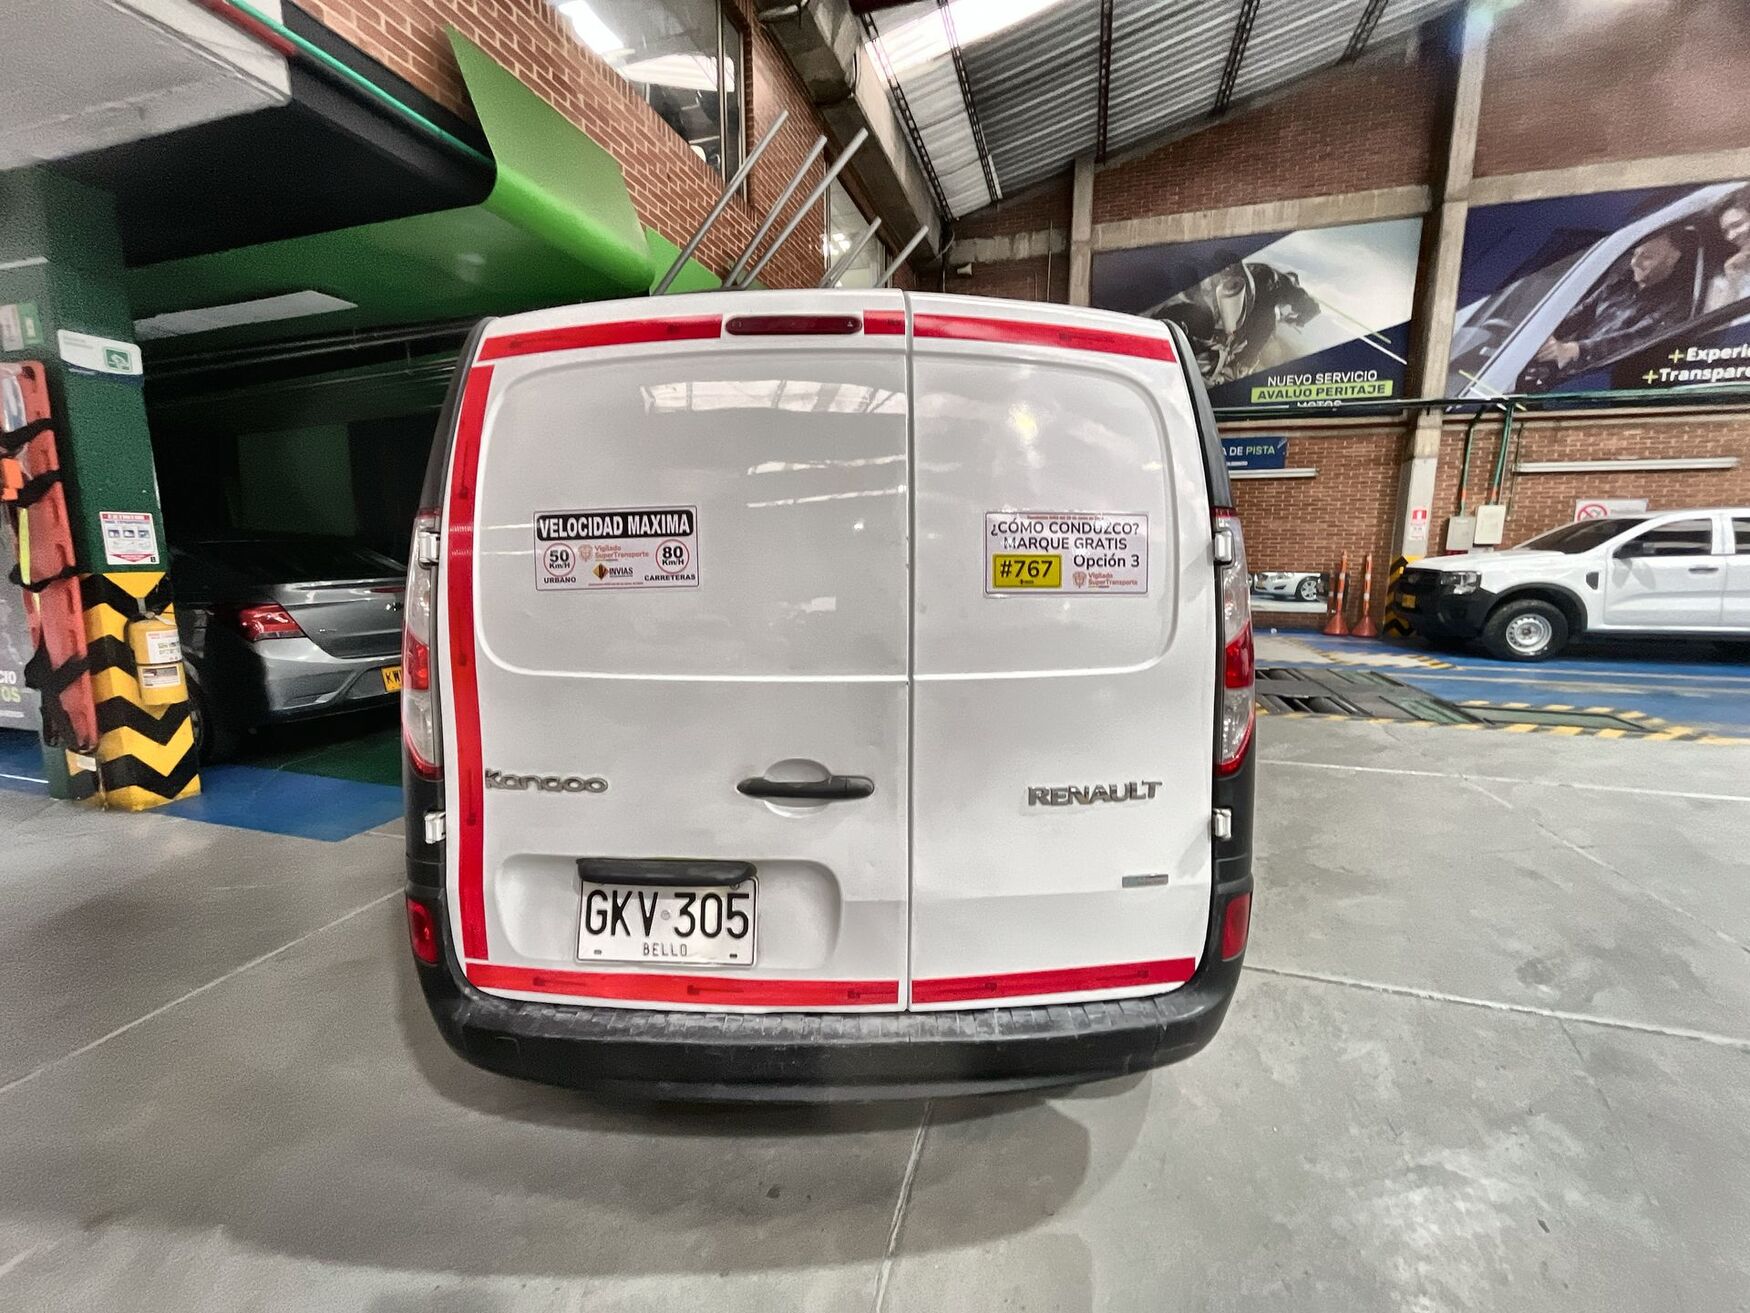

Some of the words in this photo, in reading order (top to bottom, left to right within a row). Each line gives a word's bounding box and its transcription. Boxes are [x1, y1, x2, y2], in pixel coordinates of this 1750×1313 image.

[1668, 343, 1750, 363] +Experi
[1268, 374, 1312, 386] NUEVO
[1315, 370, 1378, 384] SERVICIO
[1257, 388, 1312, 400] AVALUO
[1316, 384, 1386, 397] PERITAJE
[1229, 446, 1244, 456] DE
[1246, 445, 1275, 456] PISTA
[539, 515, 624, 538] VELOCIDAD
[627, 513, 691, 536] MAXIMA
[991, 518, 1044, 536] ¿CÓMO
[1048, 521, 1140, 535] CONDUZCO?
[662, 546, 684, 559] 80
[1003, 537, 1069, 552] MARQUE
[1074, 537, 1128, 550] GRATIS
[550, 550, 569, 562] 50
[1073, 553, 1126, 570] Opción
[1131, 555, 1140, 567] 3
[609, 567, 634, 576] INVIAS
[1000, 559, 1053, 578] #767
[543, 576, 577, 584] URBANO
[1027, 780, 1163, 806] RENAULT
[585, 889, 659, 937] GKV
[673, 892, 750, 939] 305
[643, 942, 688, 957] BELLO
